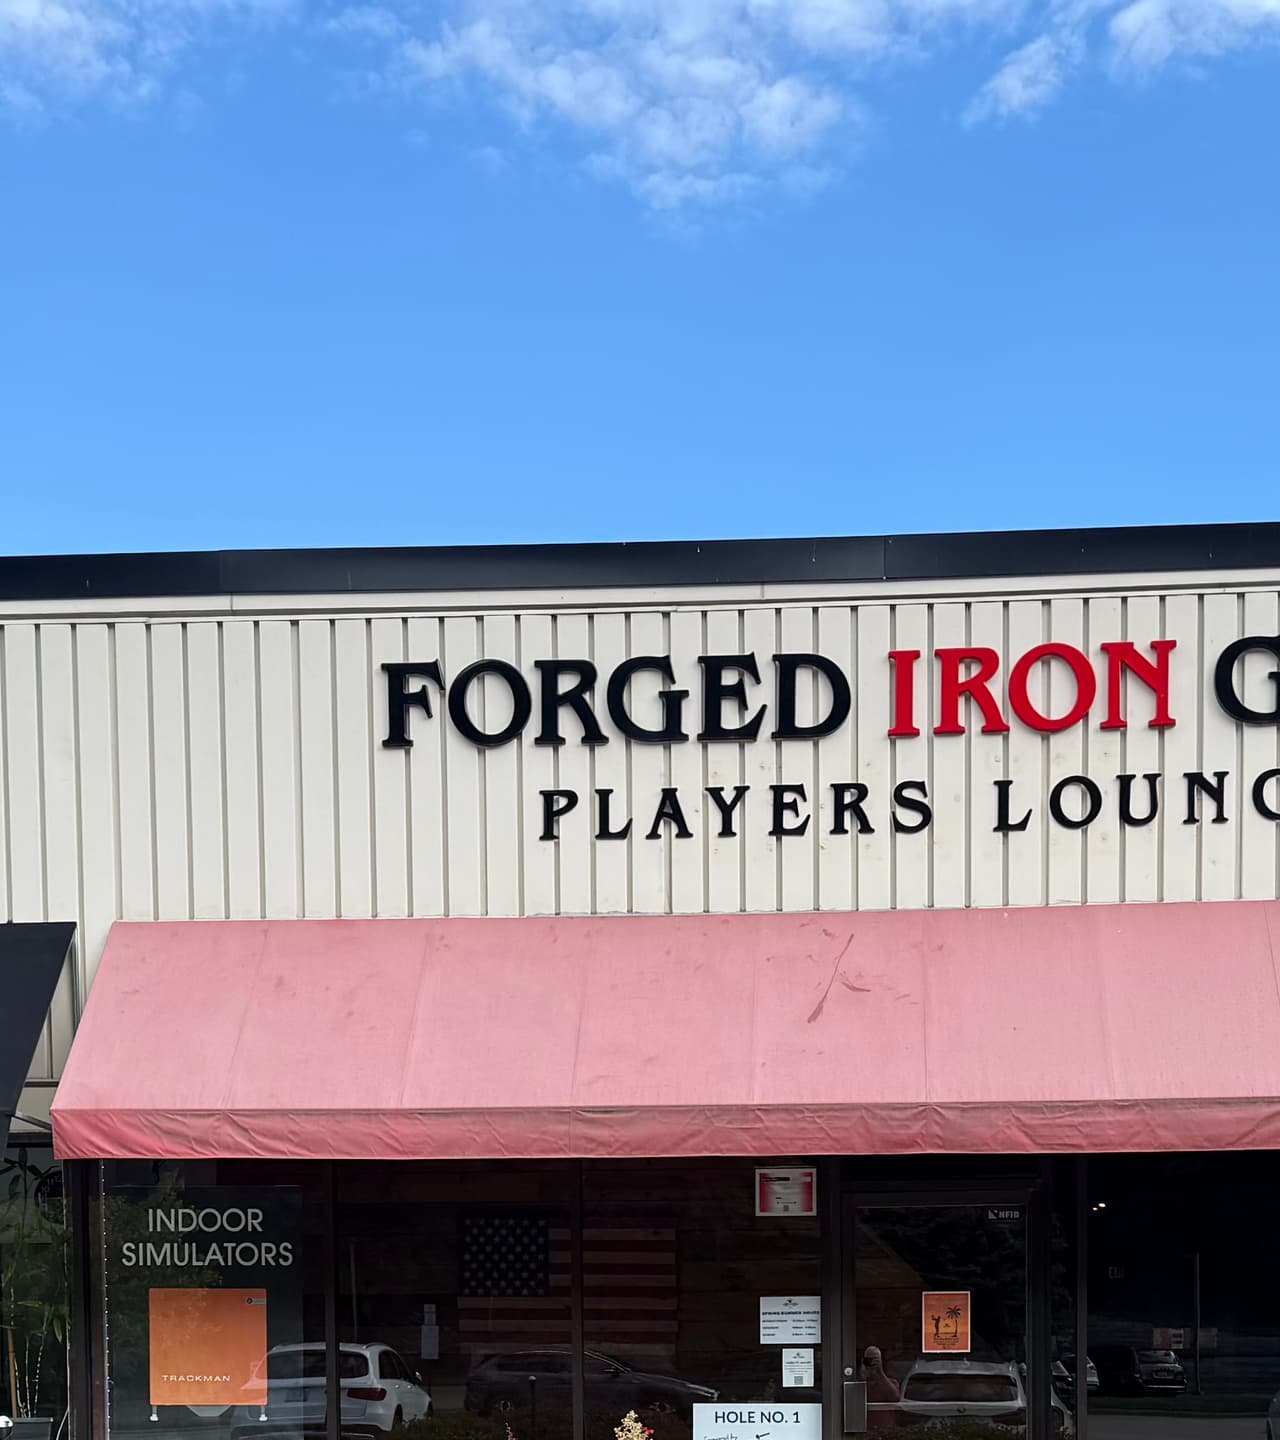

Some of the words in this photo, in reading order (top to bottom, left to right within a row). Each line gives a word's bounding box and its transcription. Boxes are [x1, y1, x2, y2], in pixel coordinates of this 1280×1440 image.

[382, 652, 852, 749] FORGED
[887, 639, 1178, 739] IRON
[539, 780, 932, 841] PLAYERS
[148, 1208, 263, 1232] INDOOR
[122, 1242, 293, 1266] SIMULATORS
[714, 1411, 755, 1423] HOLE
[760, 1411, 788, 1423] NO.
[792, 1411, 800, 1423] 1
